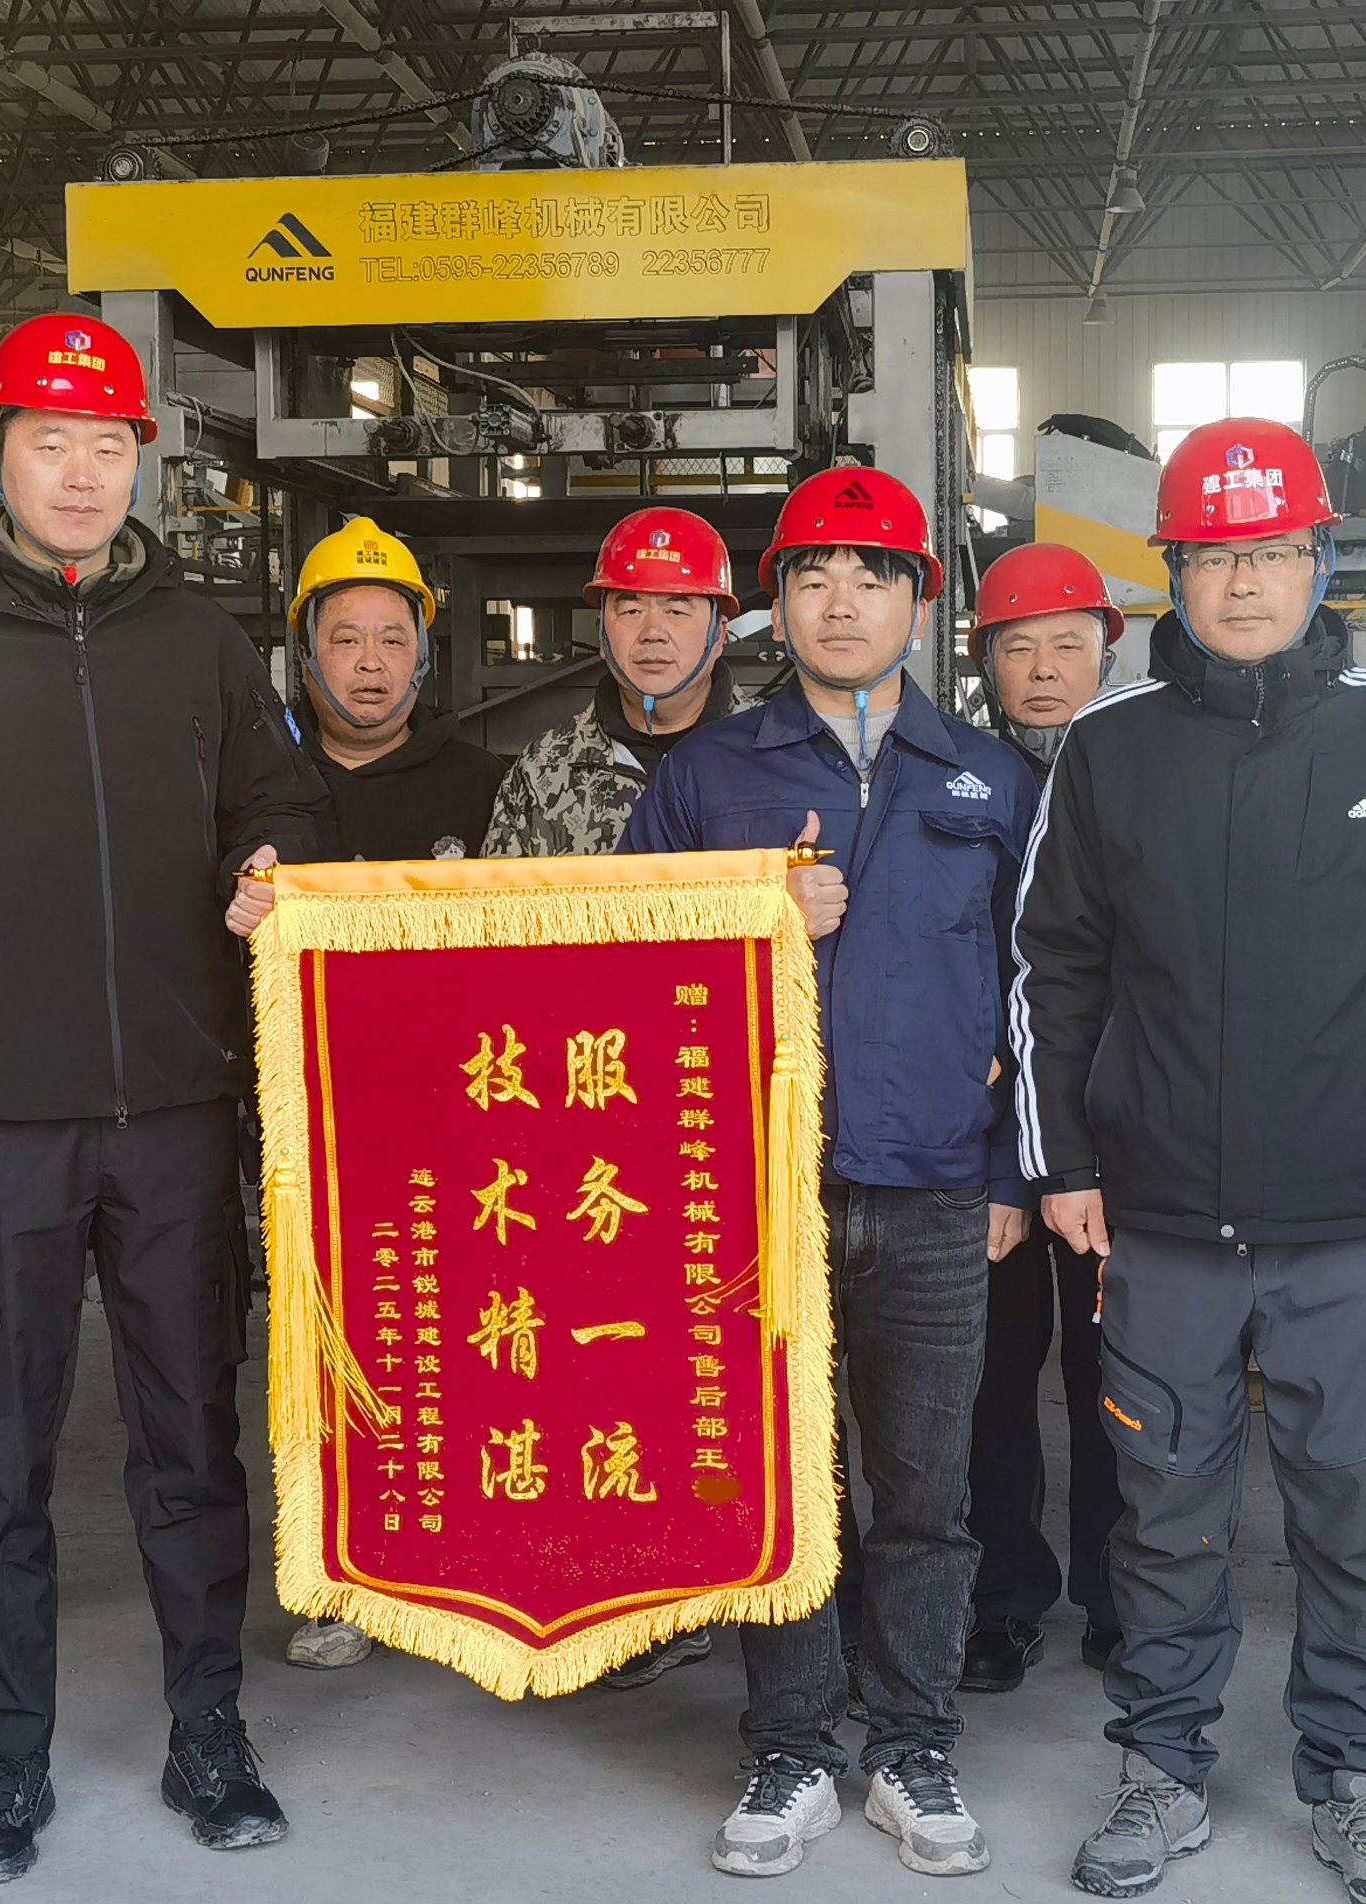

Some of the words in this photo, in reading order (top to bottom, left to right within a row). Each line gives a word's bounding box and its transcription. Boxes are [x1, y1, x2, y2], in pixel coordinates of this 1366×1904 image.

[358, 194, 771, 243] 福建群峰机械有限公司
[245, 265, 335, 282] QUNFENG
[359, 251, 620, 283] TEL:0595-22356789
[641, 248, 770, 276] 22356777
[48, 350, 106, 372] 建工集团
[1202, 468, 1284, 495] 建工集团
[834, 501, 874, 511] QUNFENG
[459, 1023, 550, 1503] 技术精湛
[673, 983, 731, 1503] 赠：福建群峰机械有限公司售后部王
[565, 1028, 658, 1503] 服务一流
[408, 1168, 444, 1534] 连云港市锐城建设工程有限公司
